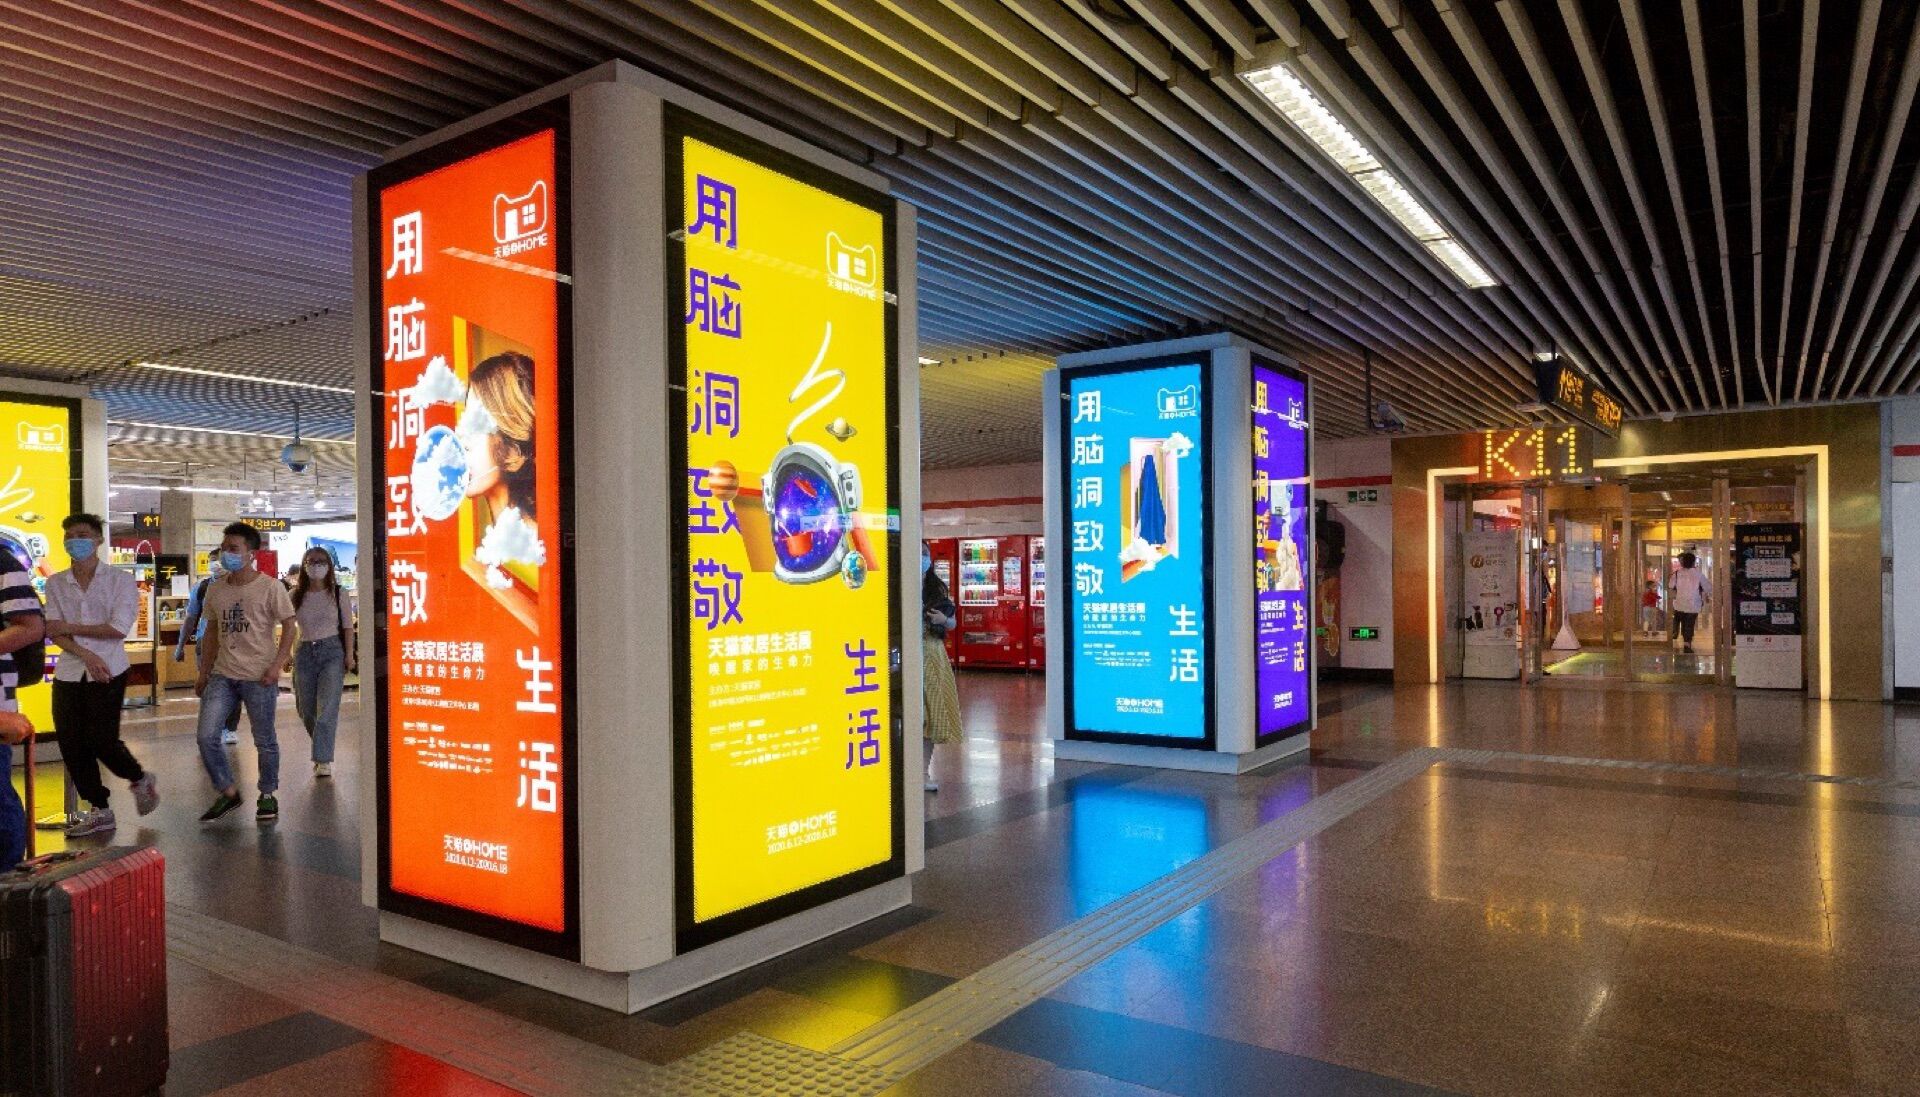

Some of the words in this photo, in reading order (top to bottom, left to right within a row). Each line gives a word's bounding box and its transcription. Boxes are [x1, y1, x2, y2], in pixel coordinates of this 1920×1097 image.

[1486, 427, 1583, 478] K11
[1072, 390, 1104, 596] 用脑洞致敬
[401, 640, 485, 663] 天猫家居生活展
[708, 631, 812, 658] 天猫家居生活展
[1168, 604, 1199, 682] 生活
[516, 646, 558, 813] 生活
[844, 639, 881, 770] 生活
